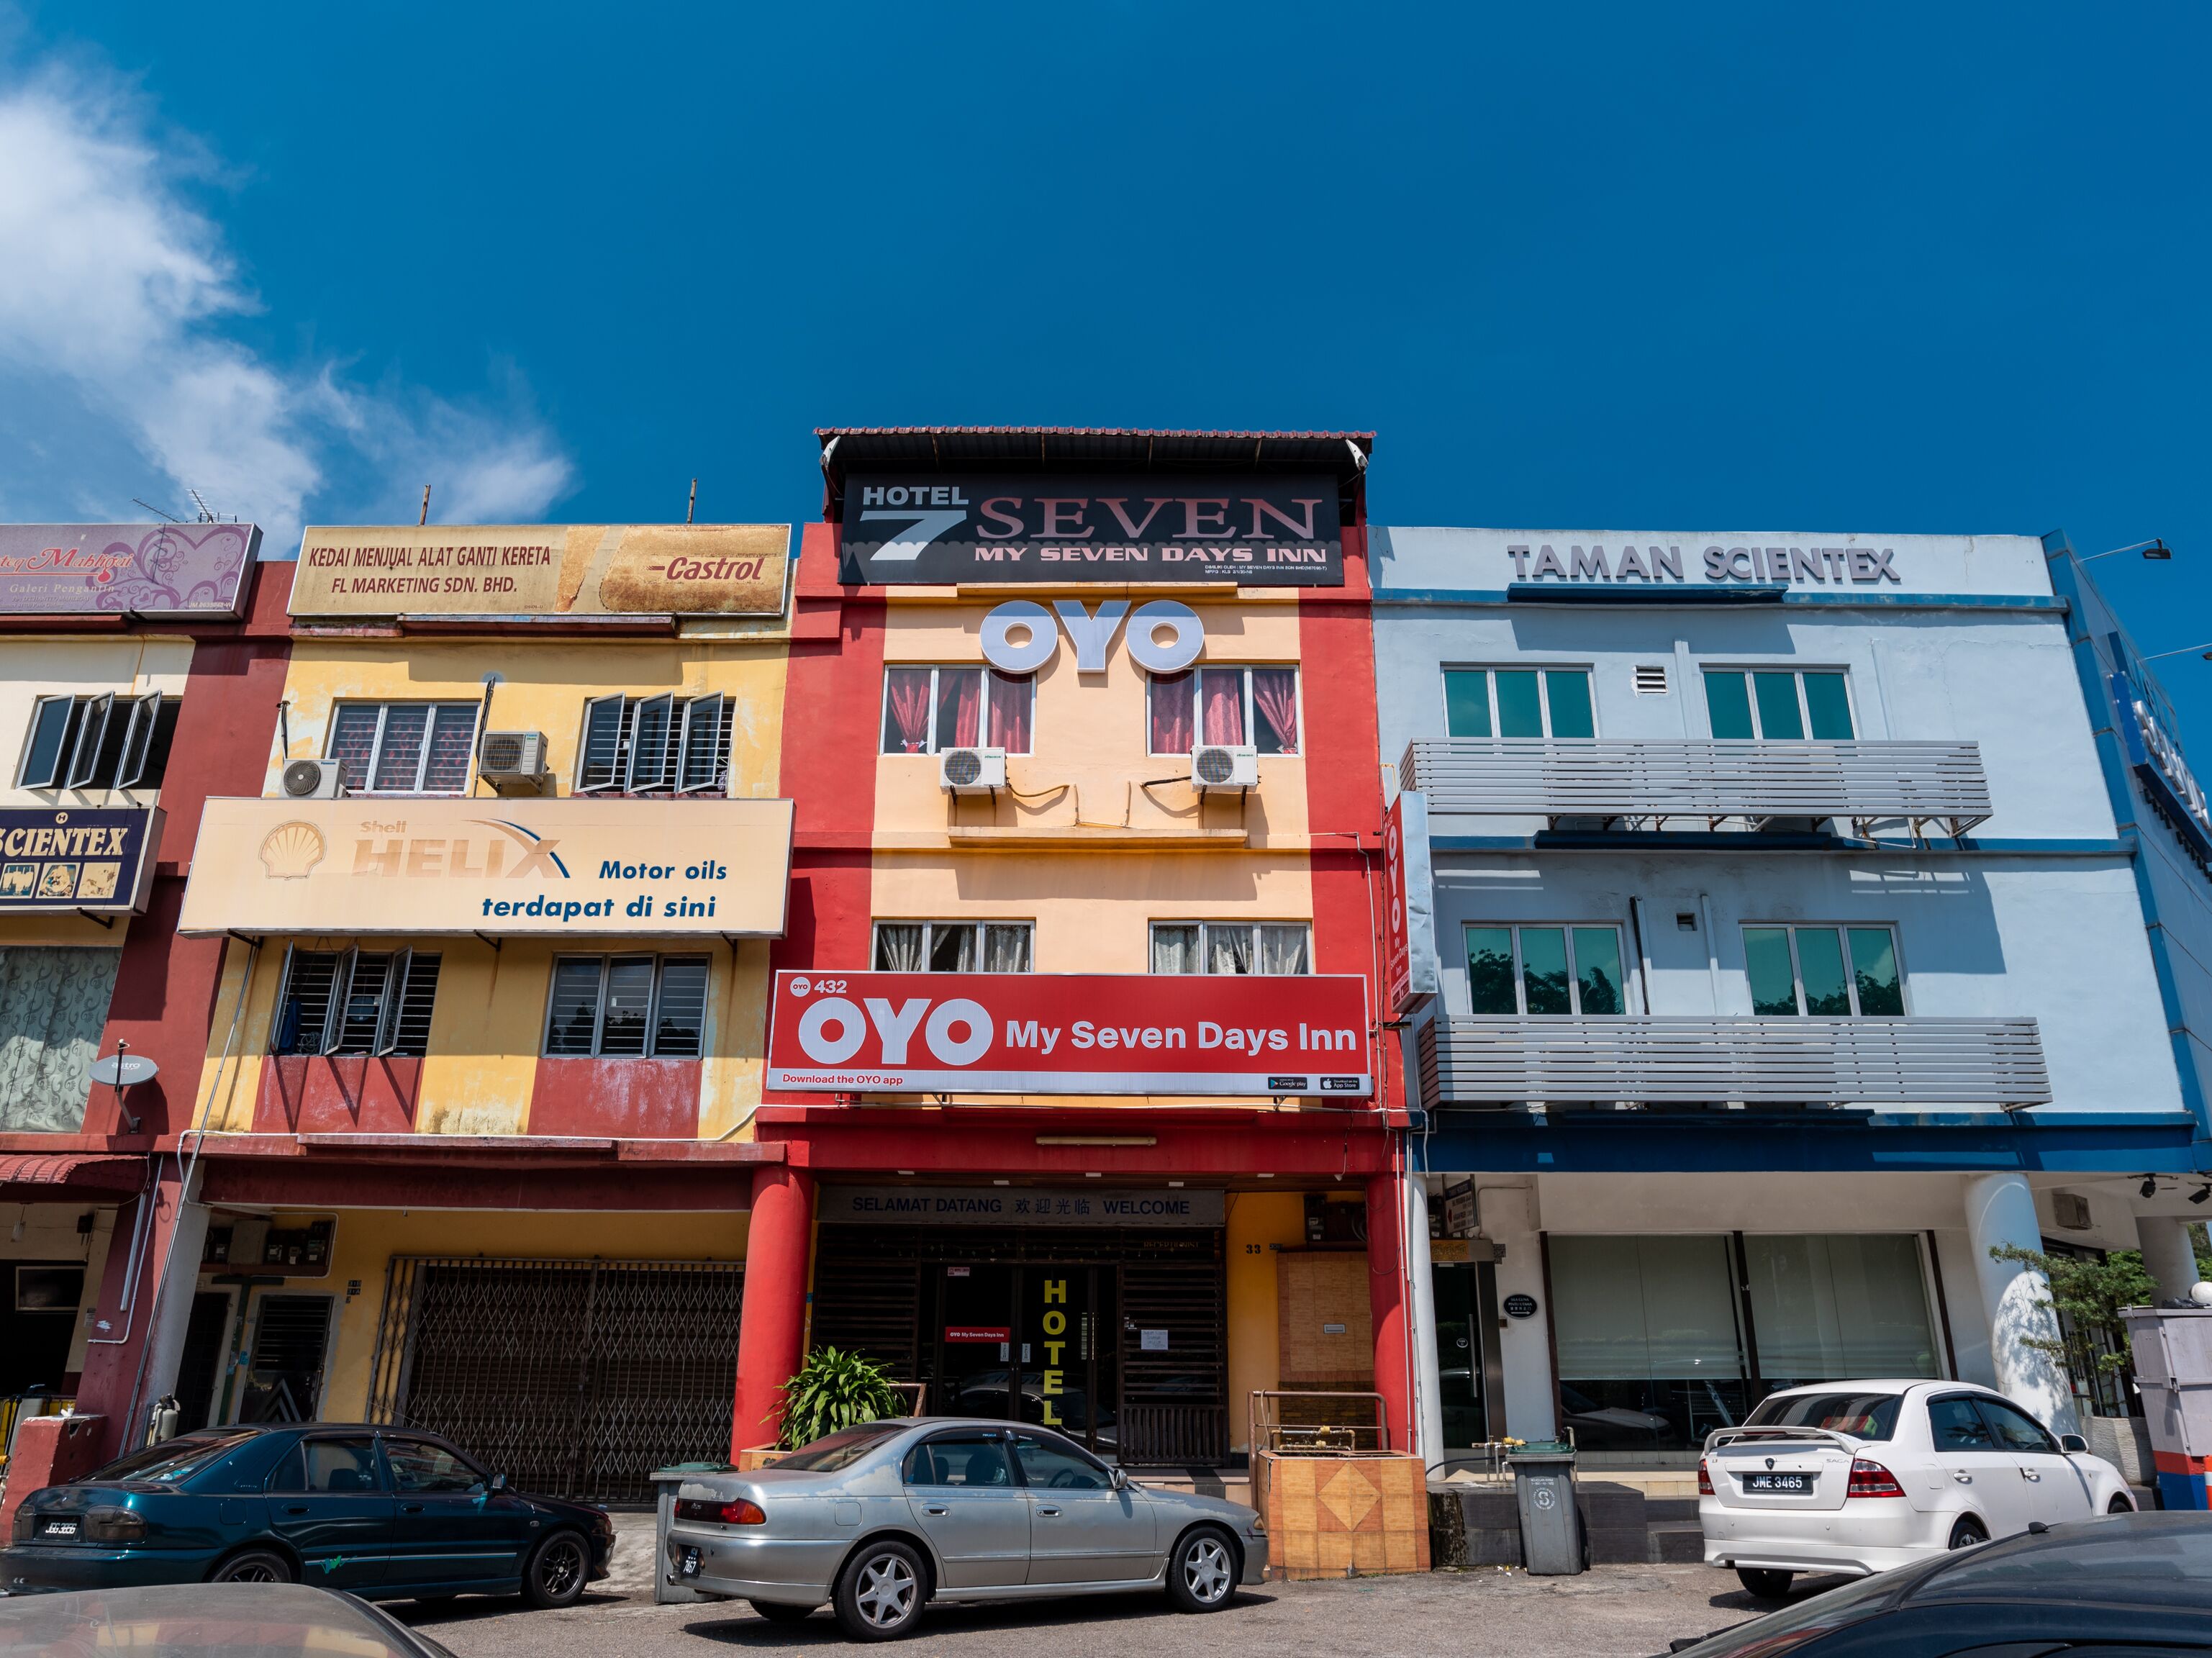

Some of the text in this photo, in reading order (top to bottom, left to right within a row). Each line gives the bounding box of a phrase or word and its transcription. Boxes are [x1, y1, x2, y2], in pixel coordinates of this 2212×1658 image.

[863, 486, 969, 505] HOTEL
[976, 497, 1323, 539] SEVEN
[859, 510, 967, 561] 7
[309, 545, 551, 566] KEDAI MENJUAL ALAT GANTI KERETA
[975, 548, 1326, 563] MY SEVEN DAYS INN
[1508, 545, 1900, 581] TAMAN SCIENTEX
[666, 557, 765, 580] Castrol
[9, 584, 115, 594] Galeri Pengantin
[331, 576, 517, 593] FL MARKETING SDN. BHD.
[979, 599, 1205, 674] OYO
[360, 820, 407, 833] Shell
[351, 838, 564, 879] HELIX
[599, 860, 727, 879] Motor oils
[1388, 825, 1401, 933] OYO
[482, 894, 716, 922] terdapat di sini
[814, 979, 848, 994] 432
[798, 997, 1357, 1066] OYO My Seven Days Inn
[782, 1074, 904, 1086] Download the OYO app
[853, 1197, 1002, 1213] SELAMAT DATANG
[1015, 1198, 1091, 1215] 欢迎光临
[1103, 1200, 1190, 1215] WELCOME
[1246, 1244, 1261, 1254] 33
[1043, 1279, 1066, 1426] HOTEL
[1752, 1476, 1803, 1488] JME 3465
